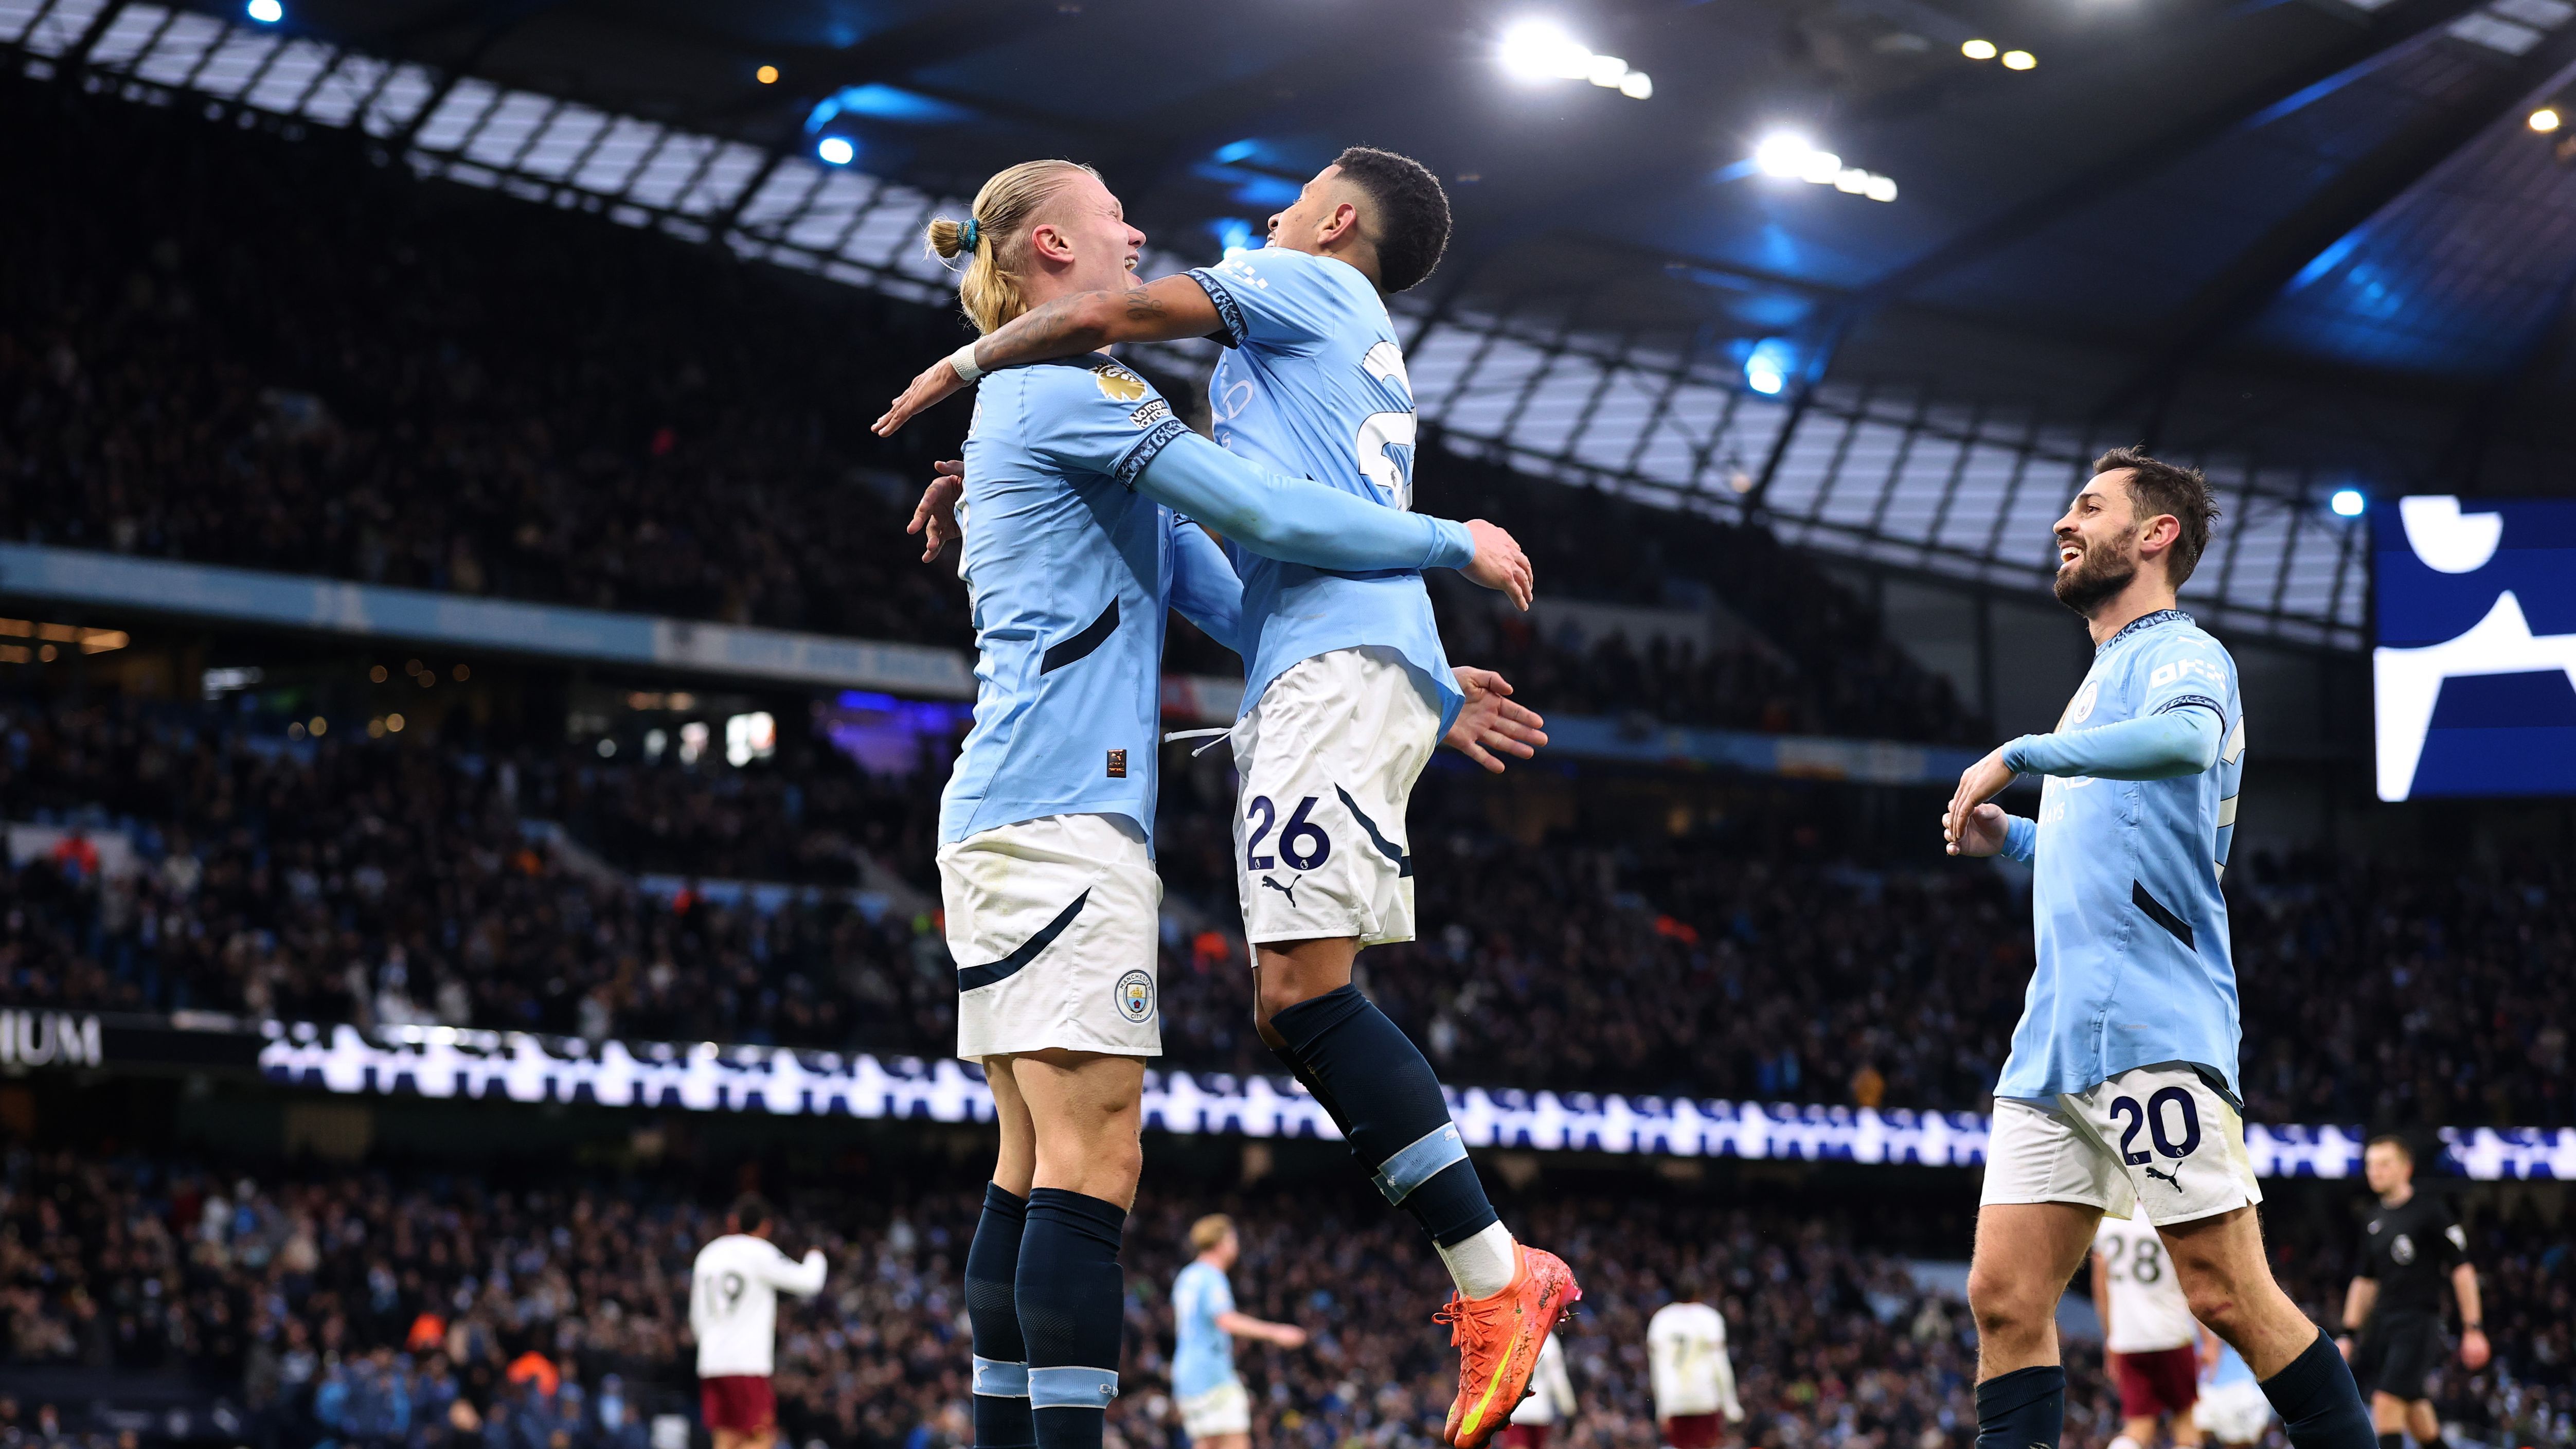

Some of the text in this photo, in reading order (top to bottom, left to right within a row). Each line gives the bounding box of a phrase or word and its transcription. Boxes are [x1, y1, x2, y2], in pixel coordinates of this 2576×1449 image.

[1129, 401, 1166, 425] No room
[2151, 658, 2226, 692] OKX
[1246, 795, 1331, 871] 26
[1120, 974, 1151, 991] MANCHESTER
[2110, 1086, 2201, 1166] 20
[2103, 1232, 2161, 1285] 28
[705, 1271, 746, 1318] 19
